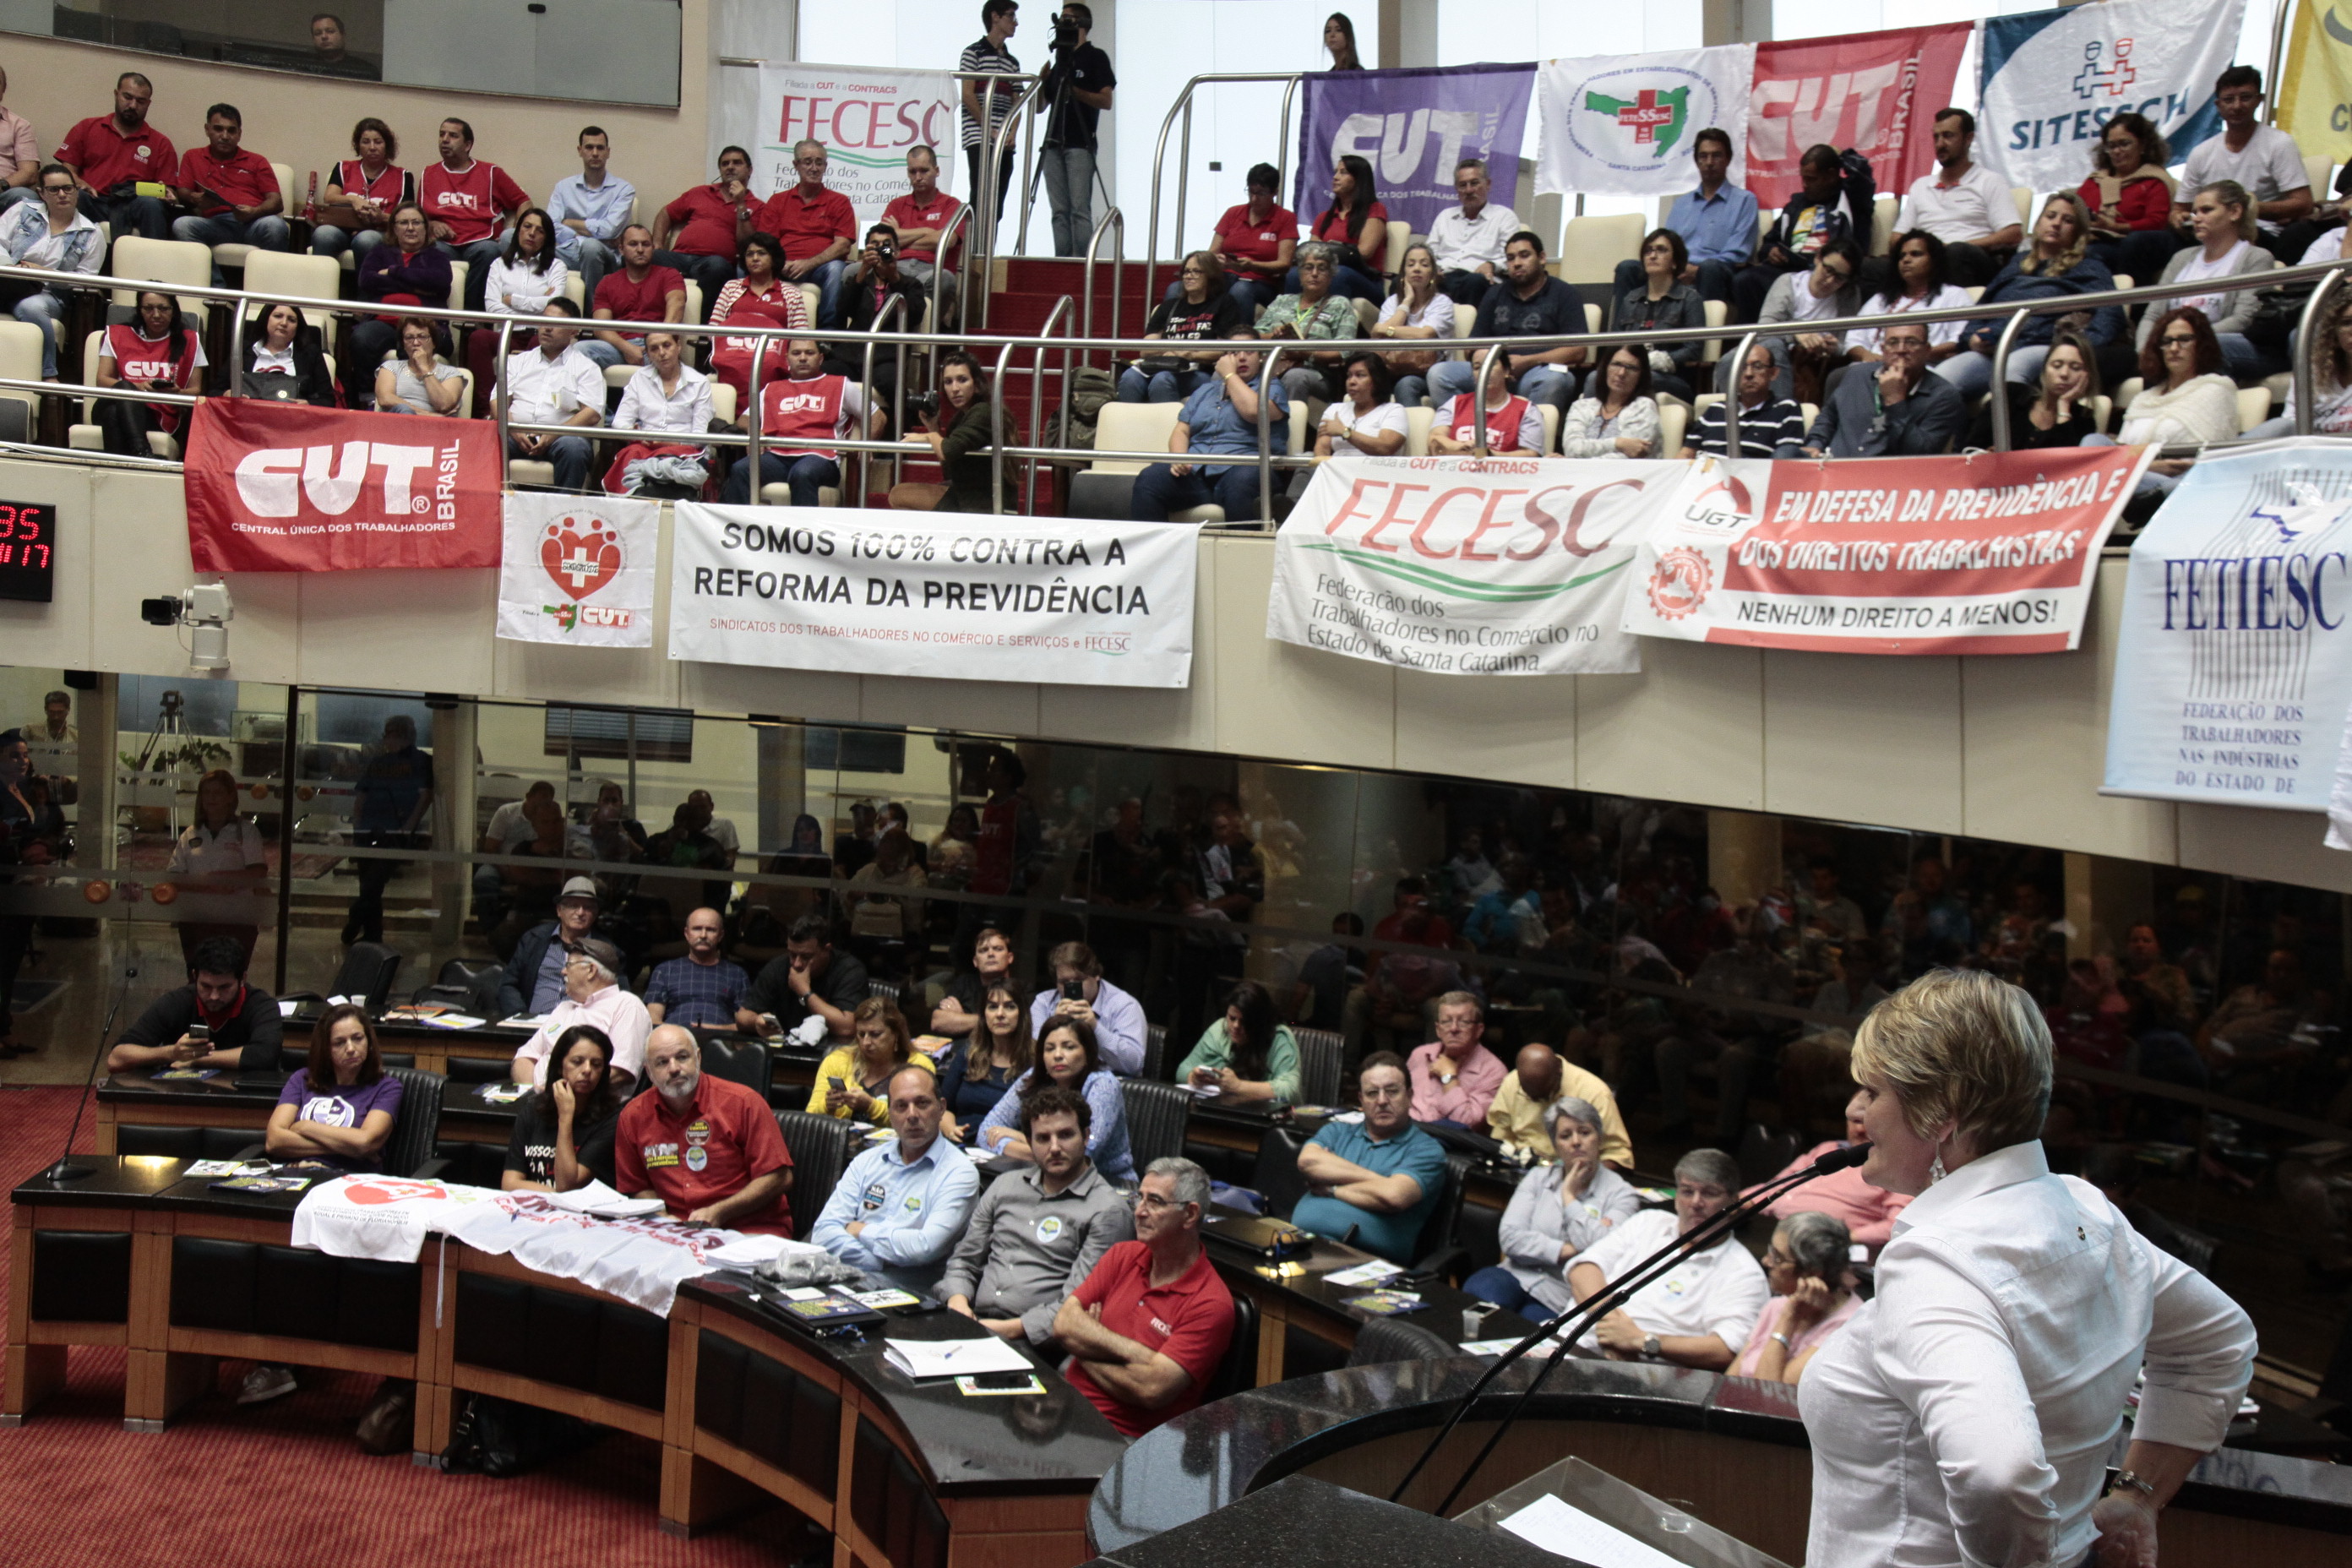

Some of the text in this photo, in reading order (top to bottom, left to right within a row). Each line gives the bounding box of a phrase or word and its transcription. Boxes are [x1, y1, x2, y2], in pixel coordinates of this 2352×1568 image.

[816, 81, 835, 90] CUT
[848, 84, 897, 94] CONTRACS
[1888, 49, 1923, 148] BRASIL
[779, 95, 950, 148] FECESC
[1748, 60, 1901, 161] CUT
[1331, 108, 1478, 186] CUT
[838, 166, 858, 178] dos
[856, 182, 871, 192] no
[438, 192, 473, 205] CUT
[780, 394, 821, 411] CUT
[235, 440, 434, 518] CUT
[436, 438, 460, 520] BRASIL
[1410, 458, 1439, 470] CUT
[1439, 461, 1447, 471] e
[1458, 460, 1538, 474] CONTRACS
[1772, 467, 2127, 523] EM DEFESA DA PREVIDÊNCIA E
[231, 521, 455, 535] CENTRAL ÚNICA DOS TRABALHADORES
[1326, 478, 1646, 561] FECESC
[1685, 504, 1751, 528] UGT
[721, 522, 1126, 566] SOMOS 100% CONTRA A
[1738, 536, 1788, 570] DOS
[1786, 540, 1897, 572] DIREITOS
[1896, 528, 2087, 570] TRABALHISTAS
[694, 567, 1150, 615] REFORMA DA PREVIDÊNCIA
[1316, 574, 1445, 618] Federação dos
[2162, 552, 2347, 631] FETIESC
[582, 607, 629, 626] CUT
[1311, 598, 1598, 646] Trabalhadores no Comércio no
[1737, 599, 2059, 628] NENHUM DIREITO A MENOS!
[710, 618, 776, 633] SINDICATOS
[780, 623, 803, 634] DOS
[806, 624, 908, 641] TRABALHADORES
[912, 631, 929, 642] NO
[933, 630, 993, 645] COMÉRCIO
[998, 634, 1004, 645] E
[1009, 634, 1069, 650] SERVIÇOS
[1086, 636, 1131, 651] FECESC
[1308, 623, 1539, 672] Estado de Santa Catarina
[2183, 701, 2304, 722] FEDERAÇÃO DOS
[2181, 725, 2302, 747] TRABALHADORES
[2179, 747, 2300, 770] NAS INDÚSTRIAS
[2175, 770, 2296, 794] DO ESTADO DE
